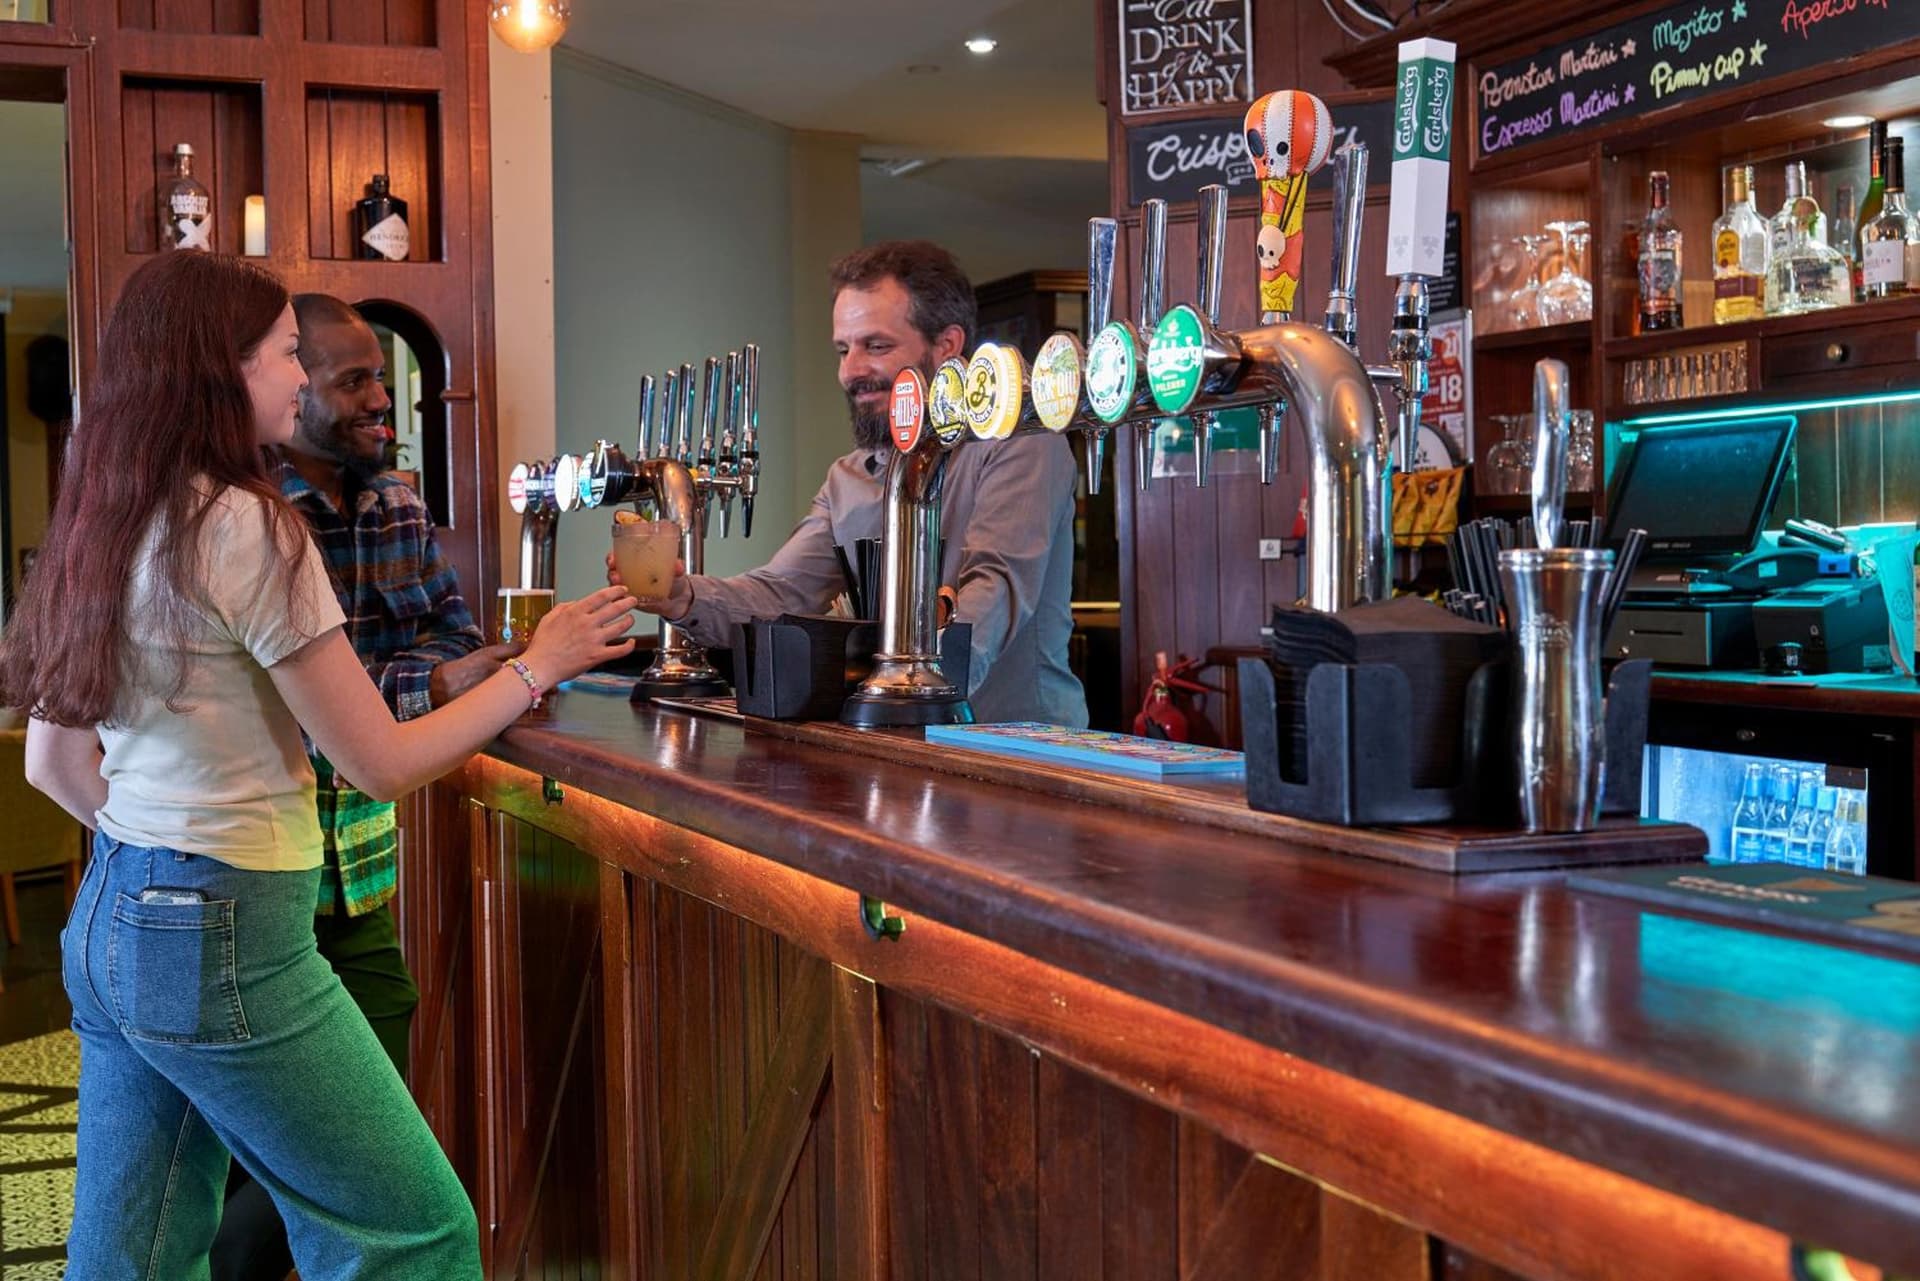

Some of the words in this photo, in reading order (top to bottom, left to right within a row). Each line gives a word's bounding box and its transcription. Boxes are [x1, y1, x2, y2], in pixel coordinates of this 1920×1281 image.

[1129, 18, 1245, 65] DRINK
[1653, 6, 1724, 53] Mojito
[1130, 64, 1243, 109] HAPPY
[1479, 61, 1556, 109] Pornstar
[1559, 42, 1618, 80] Martini
[1650, 61, 1712, 99] Pimms
[1396, 66, 1420, 153] Carlsberg
[1424, 66, 1451, 153] Carlsberg
[1482, 115, 1553, 152] Espresso
[1560, 84, 1619, 126] Martini
[1147, 135, 1250, 181] Crisp
[1440, 374, 1462, 404] 18
